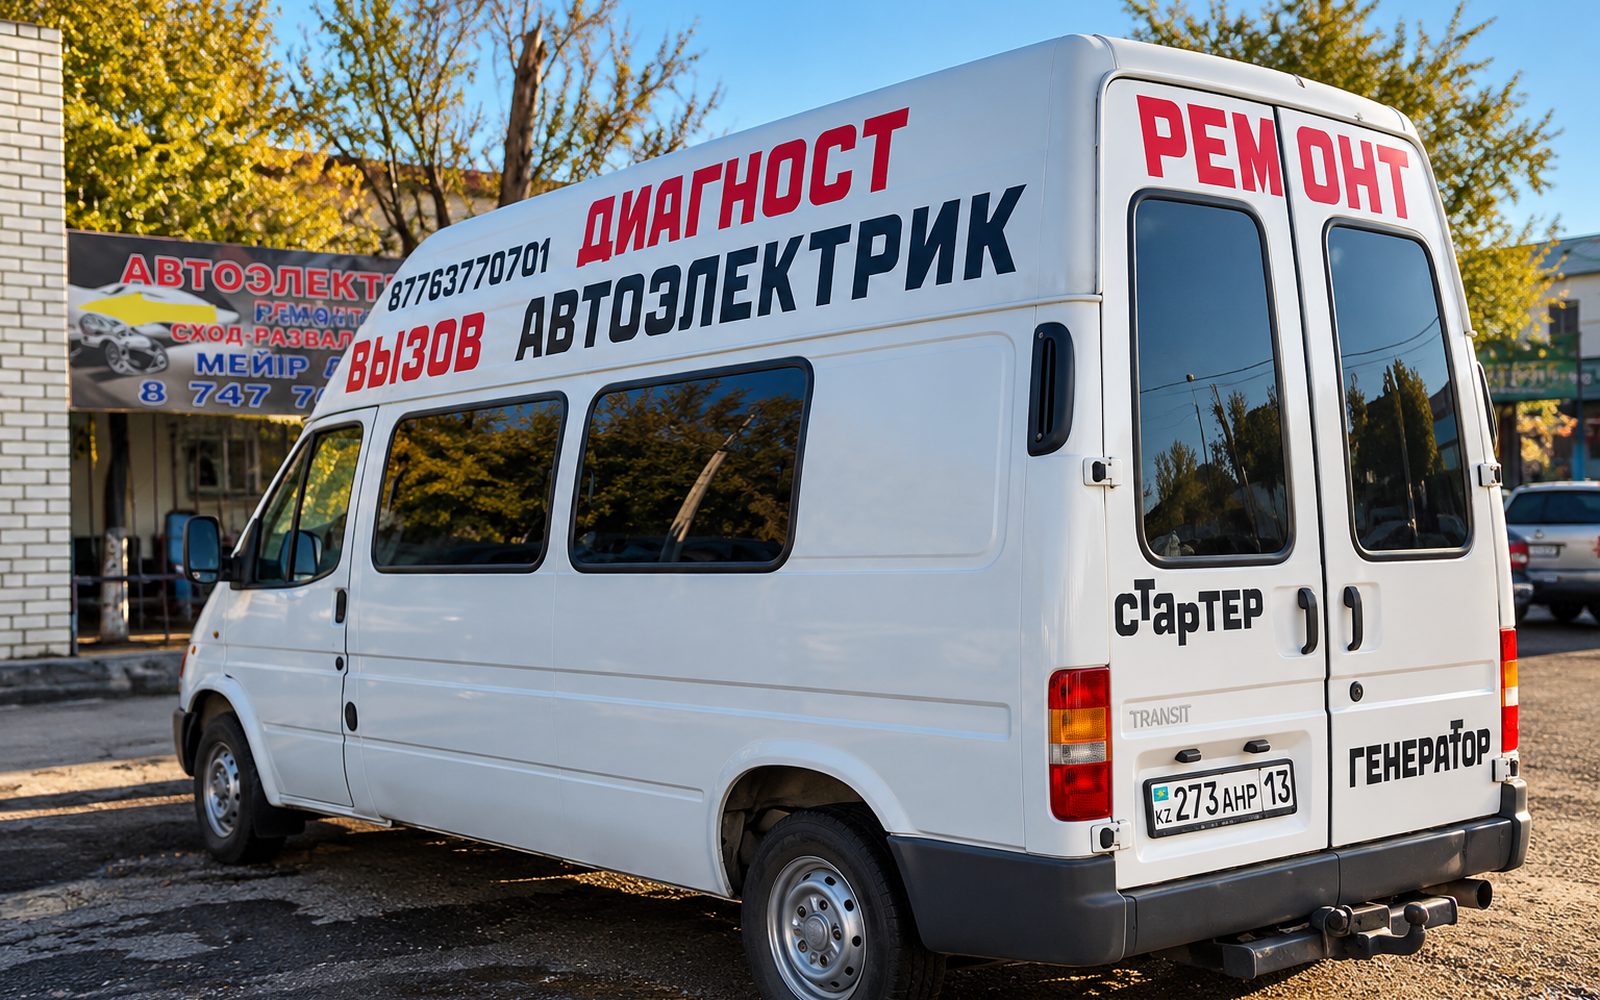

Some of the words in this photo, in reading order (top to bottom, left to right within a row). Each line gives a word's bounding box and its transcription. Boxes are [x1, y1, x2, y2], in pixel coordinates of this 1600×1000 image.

[577, 107, 909, 267] ДИАГНОСТ
[121, 253, 395, 301] АВТОЭЛЕКТ
[388, 237, 551, 312] 87763770701
[515, 184, 1026, 361] АВТОЭЛЕКТРИК
[346, 312, 485, 392] ВЫЗОВ
[138, 380, 168, 405] 8
[188, 382, 271, 407] 747
[1129, 704, 1192, 729] TRANSIT
[1349, 719, 1491, 788] ГЕНЕРАТОР
[1155, 808, 1173, 825] KZ
[1174, 780, 1219, 822] 273
[1263, 769, 1291, 806] 13
